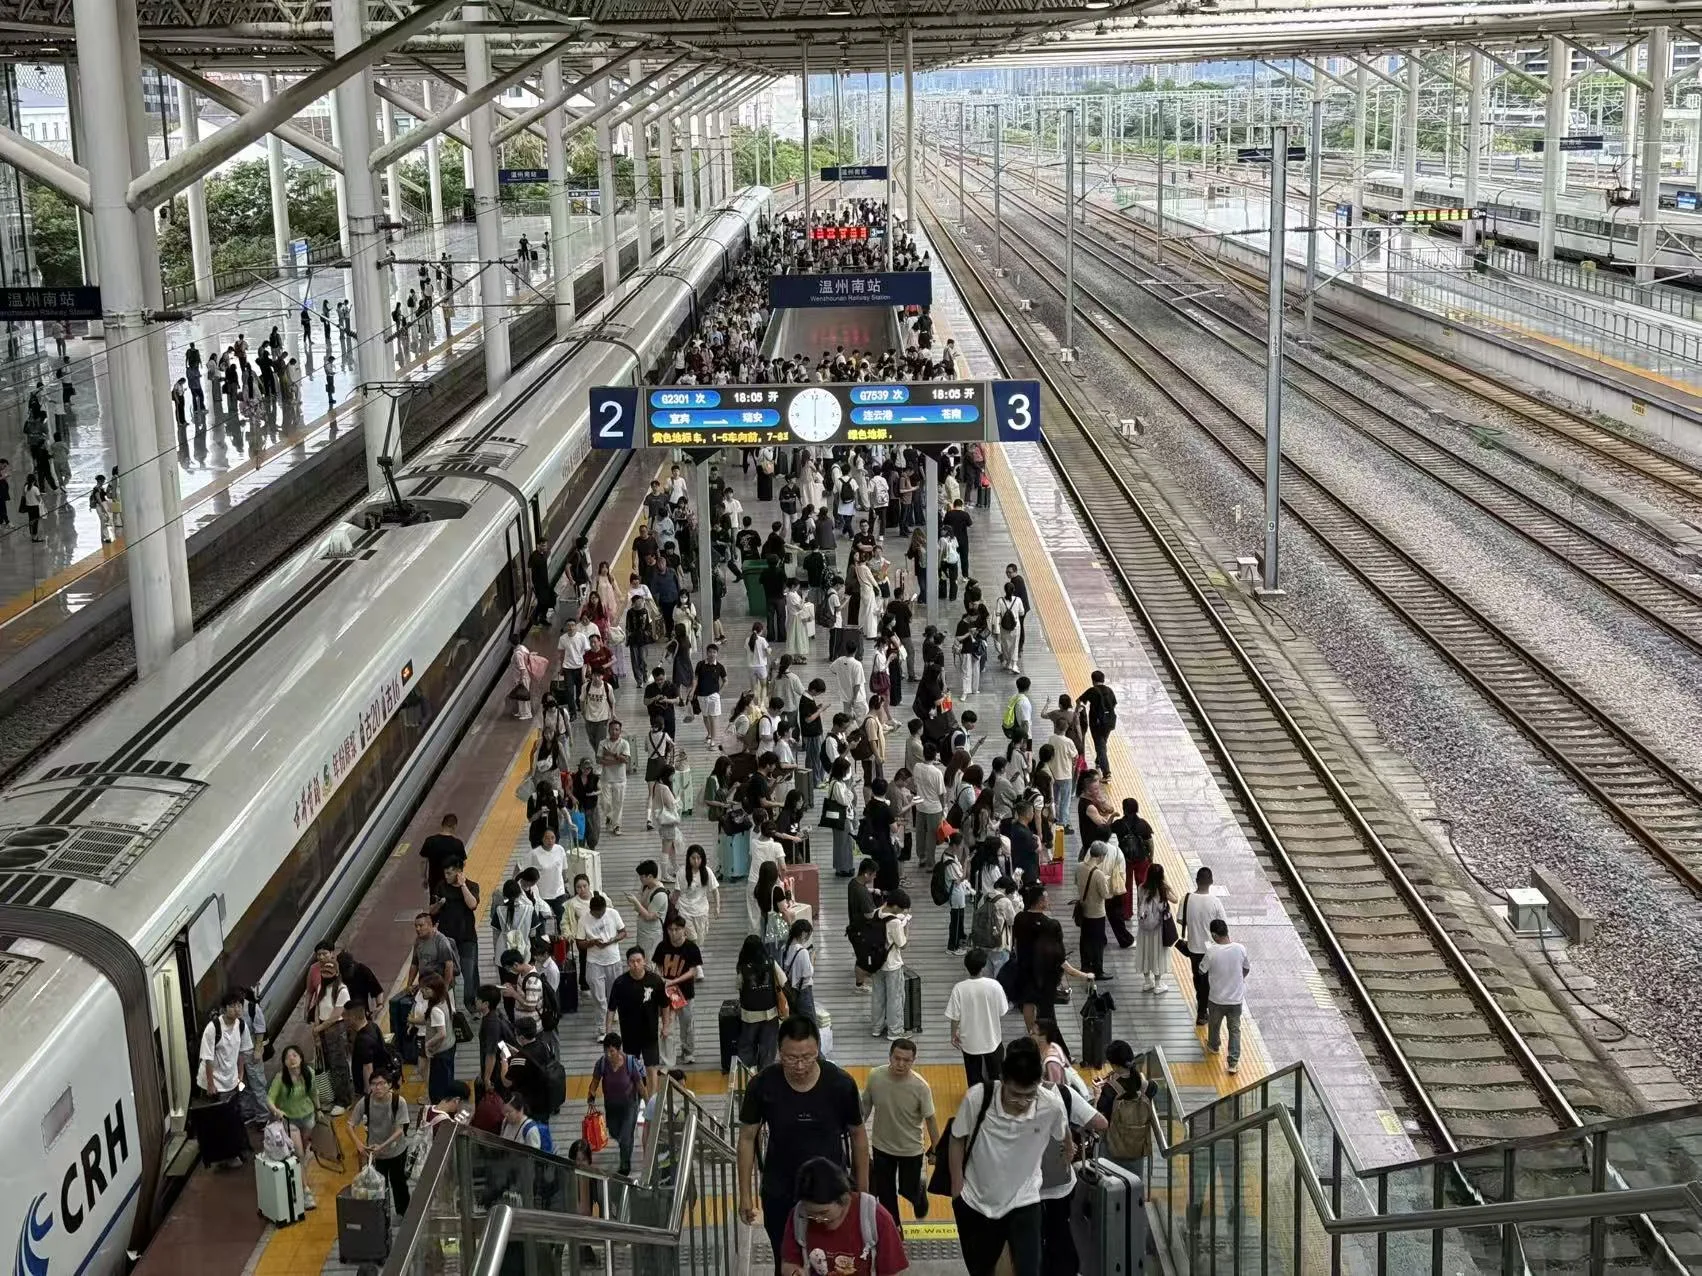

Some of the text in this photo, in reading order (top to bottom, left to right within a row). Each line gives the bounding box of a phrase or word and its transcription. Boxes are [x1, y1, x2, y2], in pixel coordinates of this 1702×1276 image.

[819, 278, 881, 294] 温州南站
[7, 291, 76, 308] 温州南站
[848, 294, 870, 302] Railway
[661, 391, 779, 404] G2301 次 18:05 开
[860, 388, 975, 401] G7539 次 18:05 开
[599, 400, 624, 438] 2
[863, 409, 894, 421] 连云港
[1007, 393, 1032, 431] 3
[1268, 521, 1275, 531] 9
[61, 1098, 129, 1234] CRH
